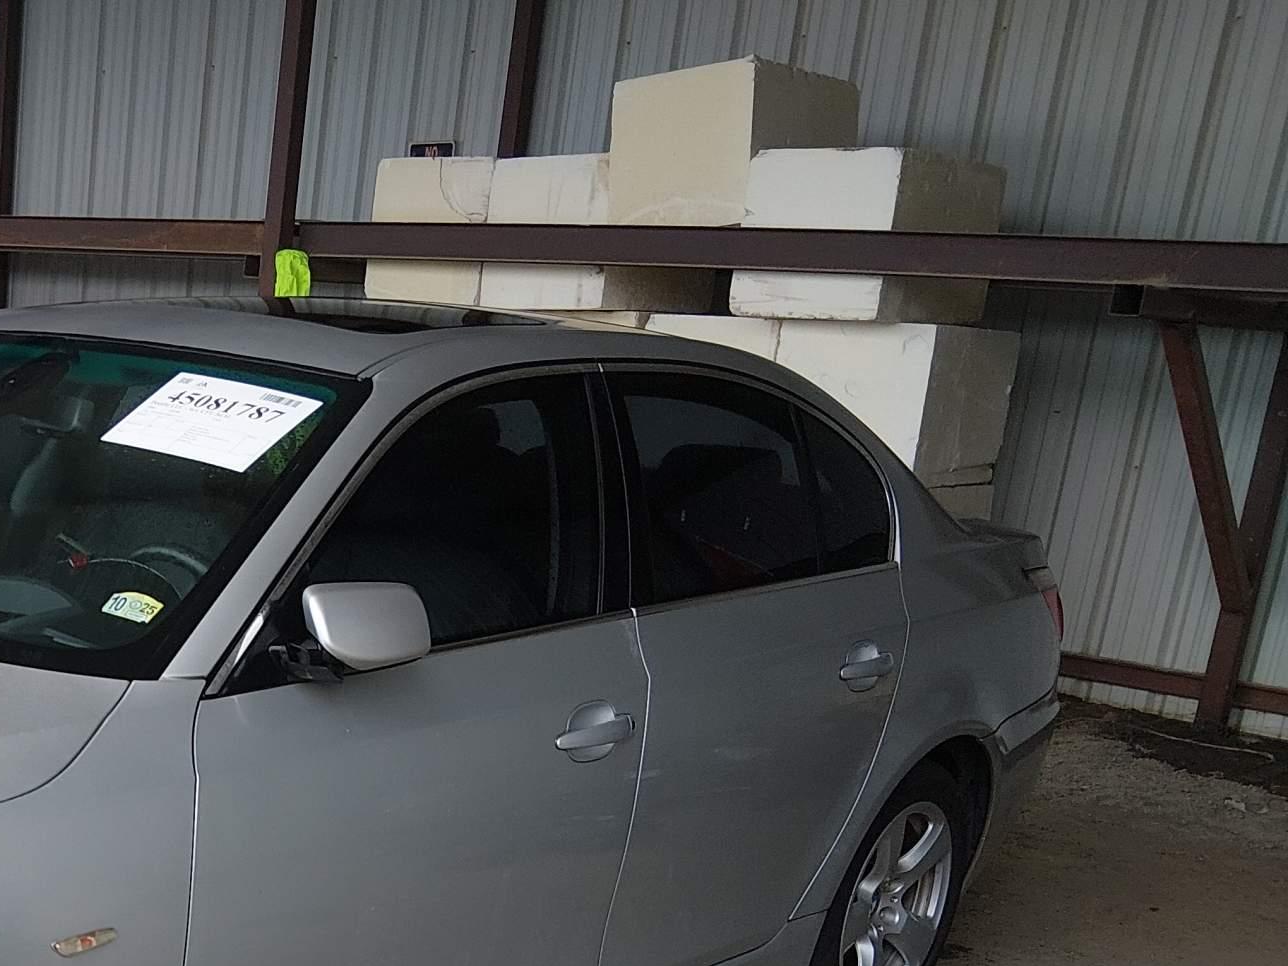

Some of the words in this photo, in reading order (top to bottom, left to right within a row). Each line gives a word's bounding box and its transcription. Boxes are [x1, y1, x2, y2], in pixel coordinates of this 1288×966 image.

[168, 391, 286, 422] 45081787
[108, 595, 128, 611] 10
[139, 603, 158, 616] 25
